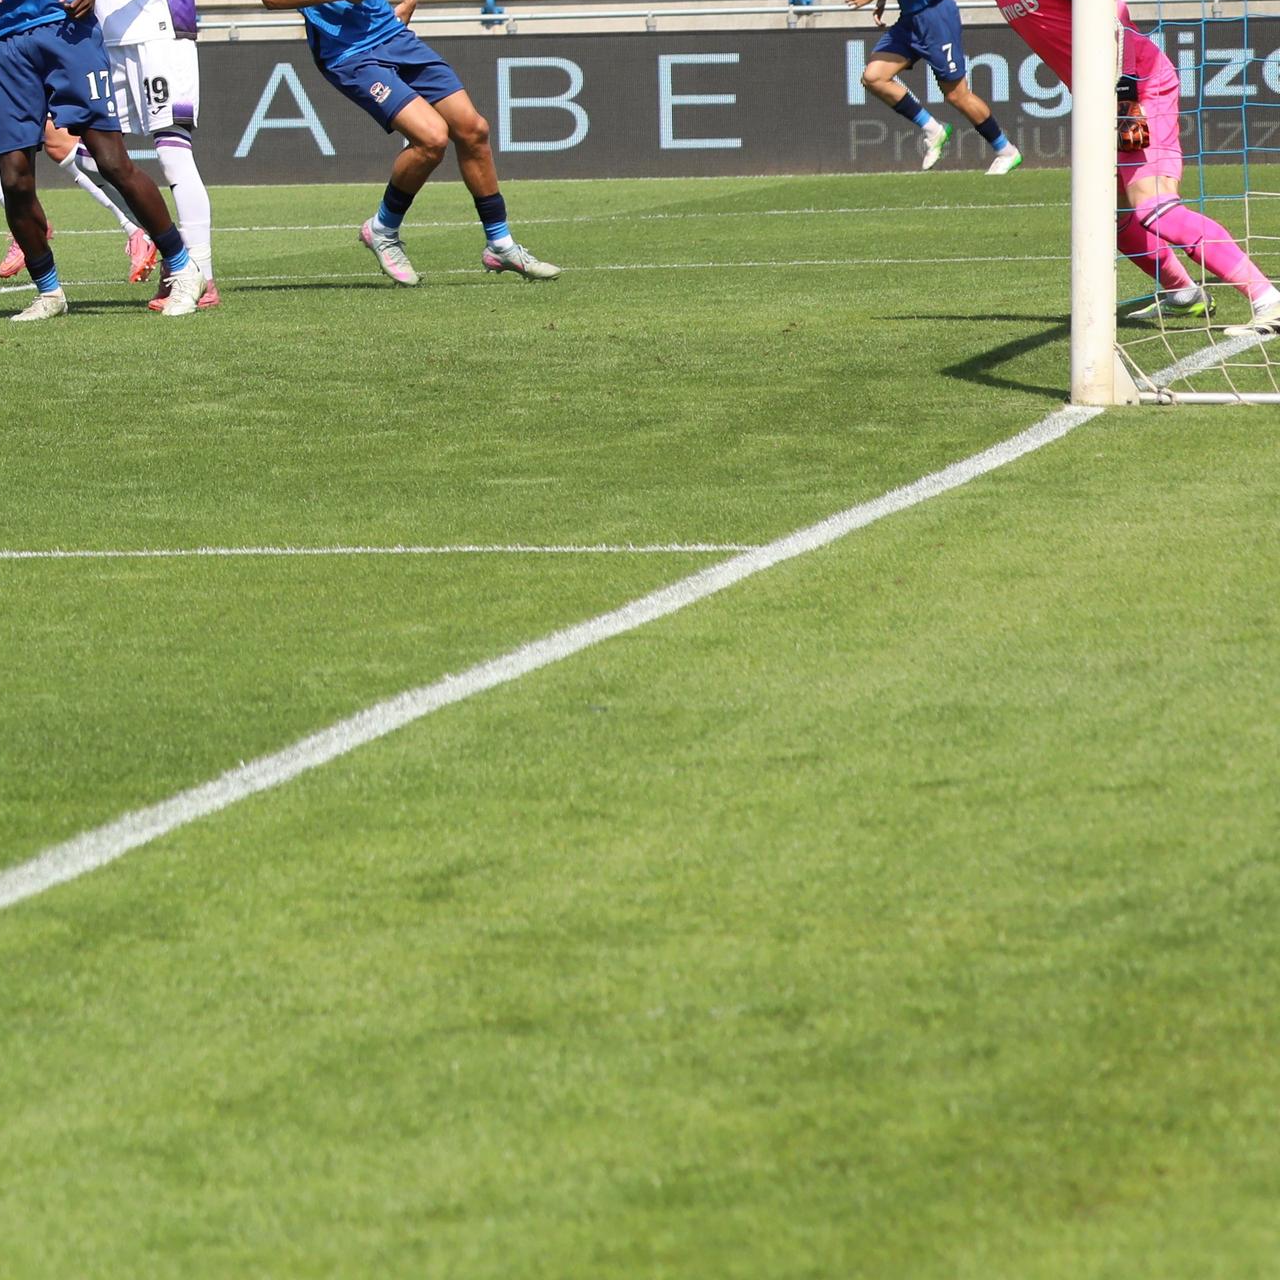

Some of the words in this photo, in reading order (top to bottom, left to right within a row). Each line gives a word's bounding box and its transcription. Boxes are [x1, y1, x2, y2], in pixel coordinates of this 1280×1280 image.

[942, 42, 954, 63] 7
[86, 70, 112, 101] 17
[143, 76, 170, 106] 19
